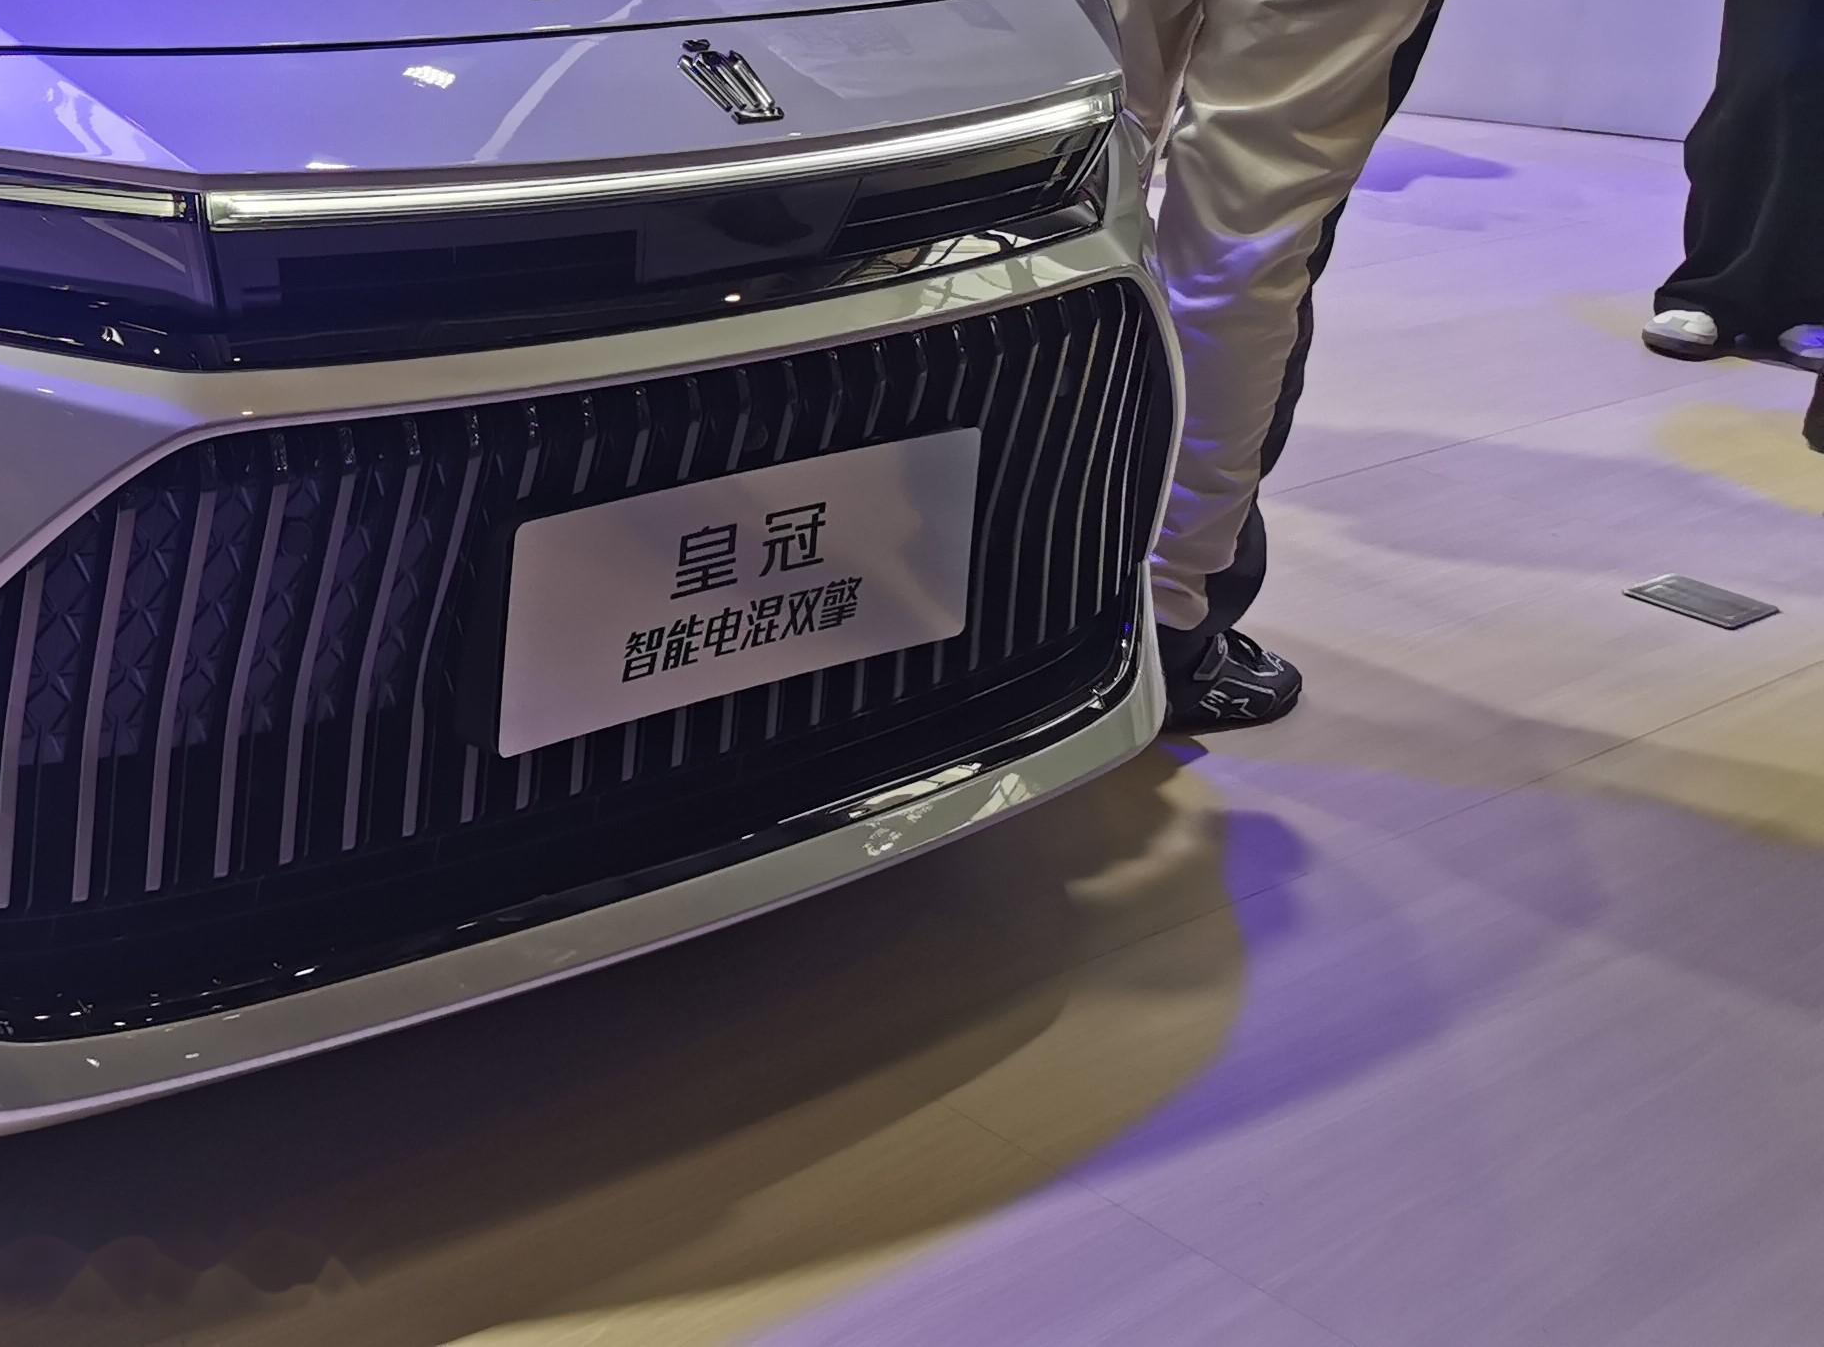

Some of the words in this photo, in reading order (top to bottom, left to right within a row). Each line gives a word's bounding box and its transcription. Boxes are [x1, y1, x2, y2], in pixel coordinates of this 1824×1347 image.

[670, 501, 827, 600] 皇冠
[621, 576, 864, 684] 智能电混双擎
